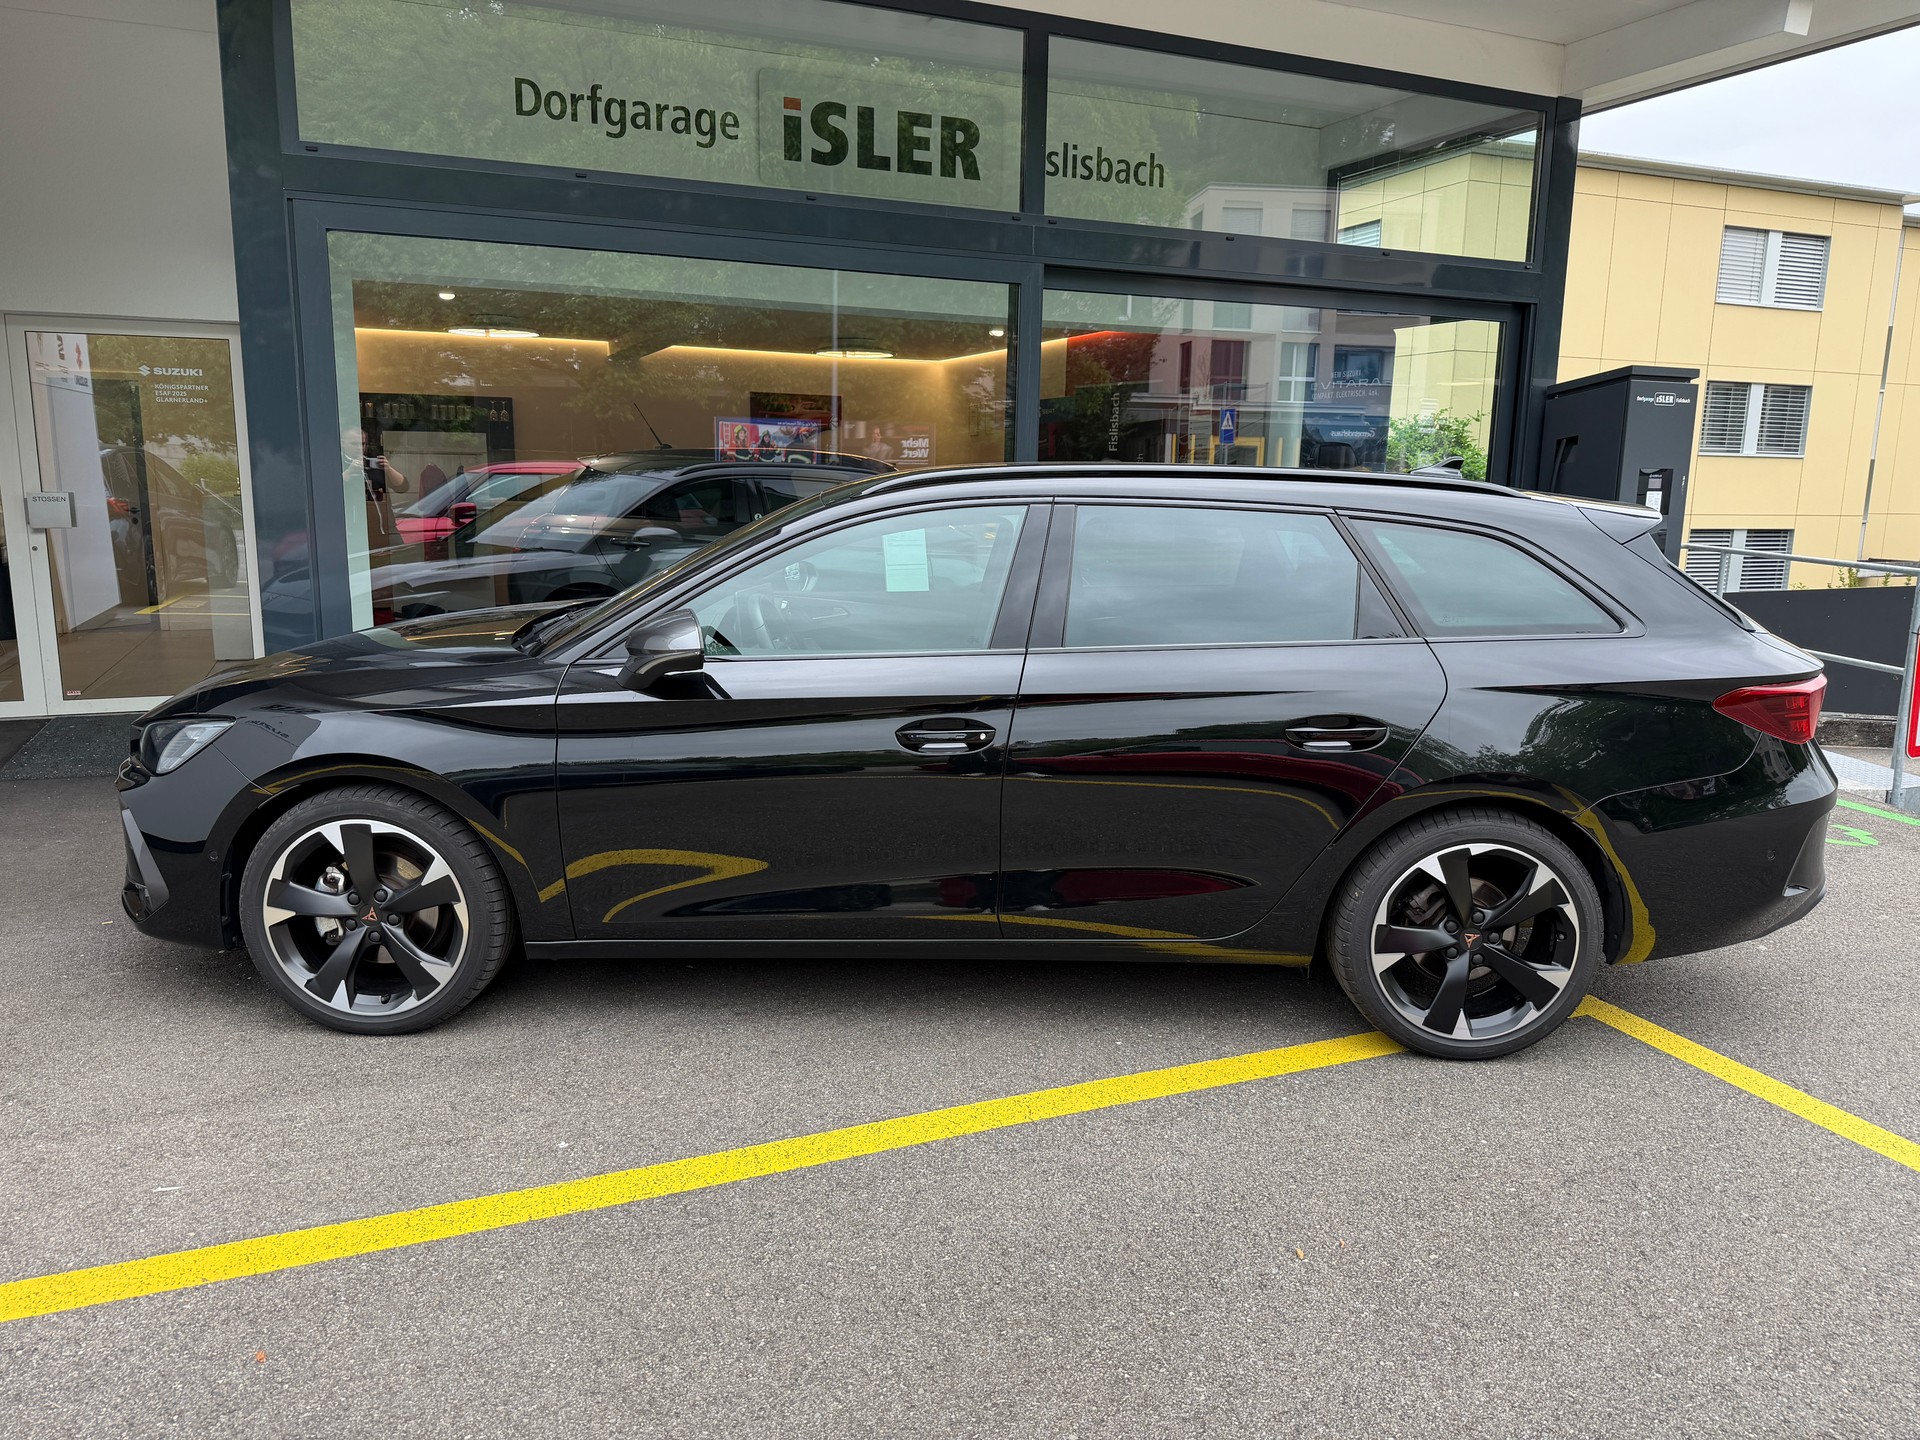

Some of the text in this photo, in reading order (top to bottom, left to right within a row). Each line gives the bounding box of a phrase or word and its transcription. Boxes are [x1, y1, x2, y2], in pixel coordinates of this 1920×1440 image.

[514, 77, 740, 148] Dorfgarage
[783, 96, 981, 181] iSLER
[153, 367, 203, 376] SUZUKI
[1321, 378, 1382, 390] VITARA
[1109, 392, 1120, 452] Fislisbach
